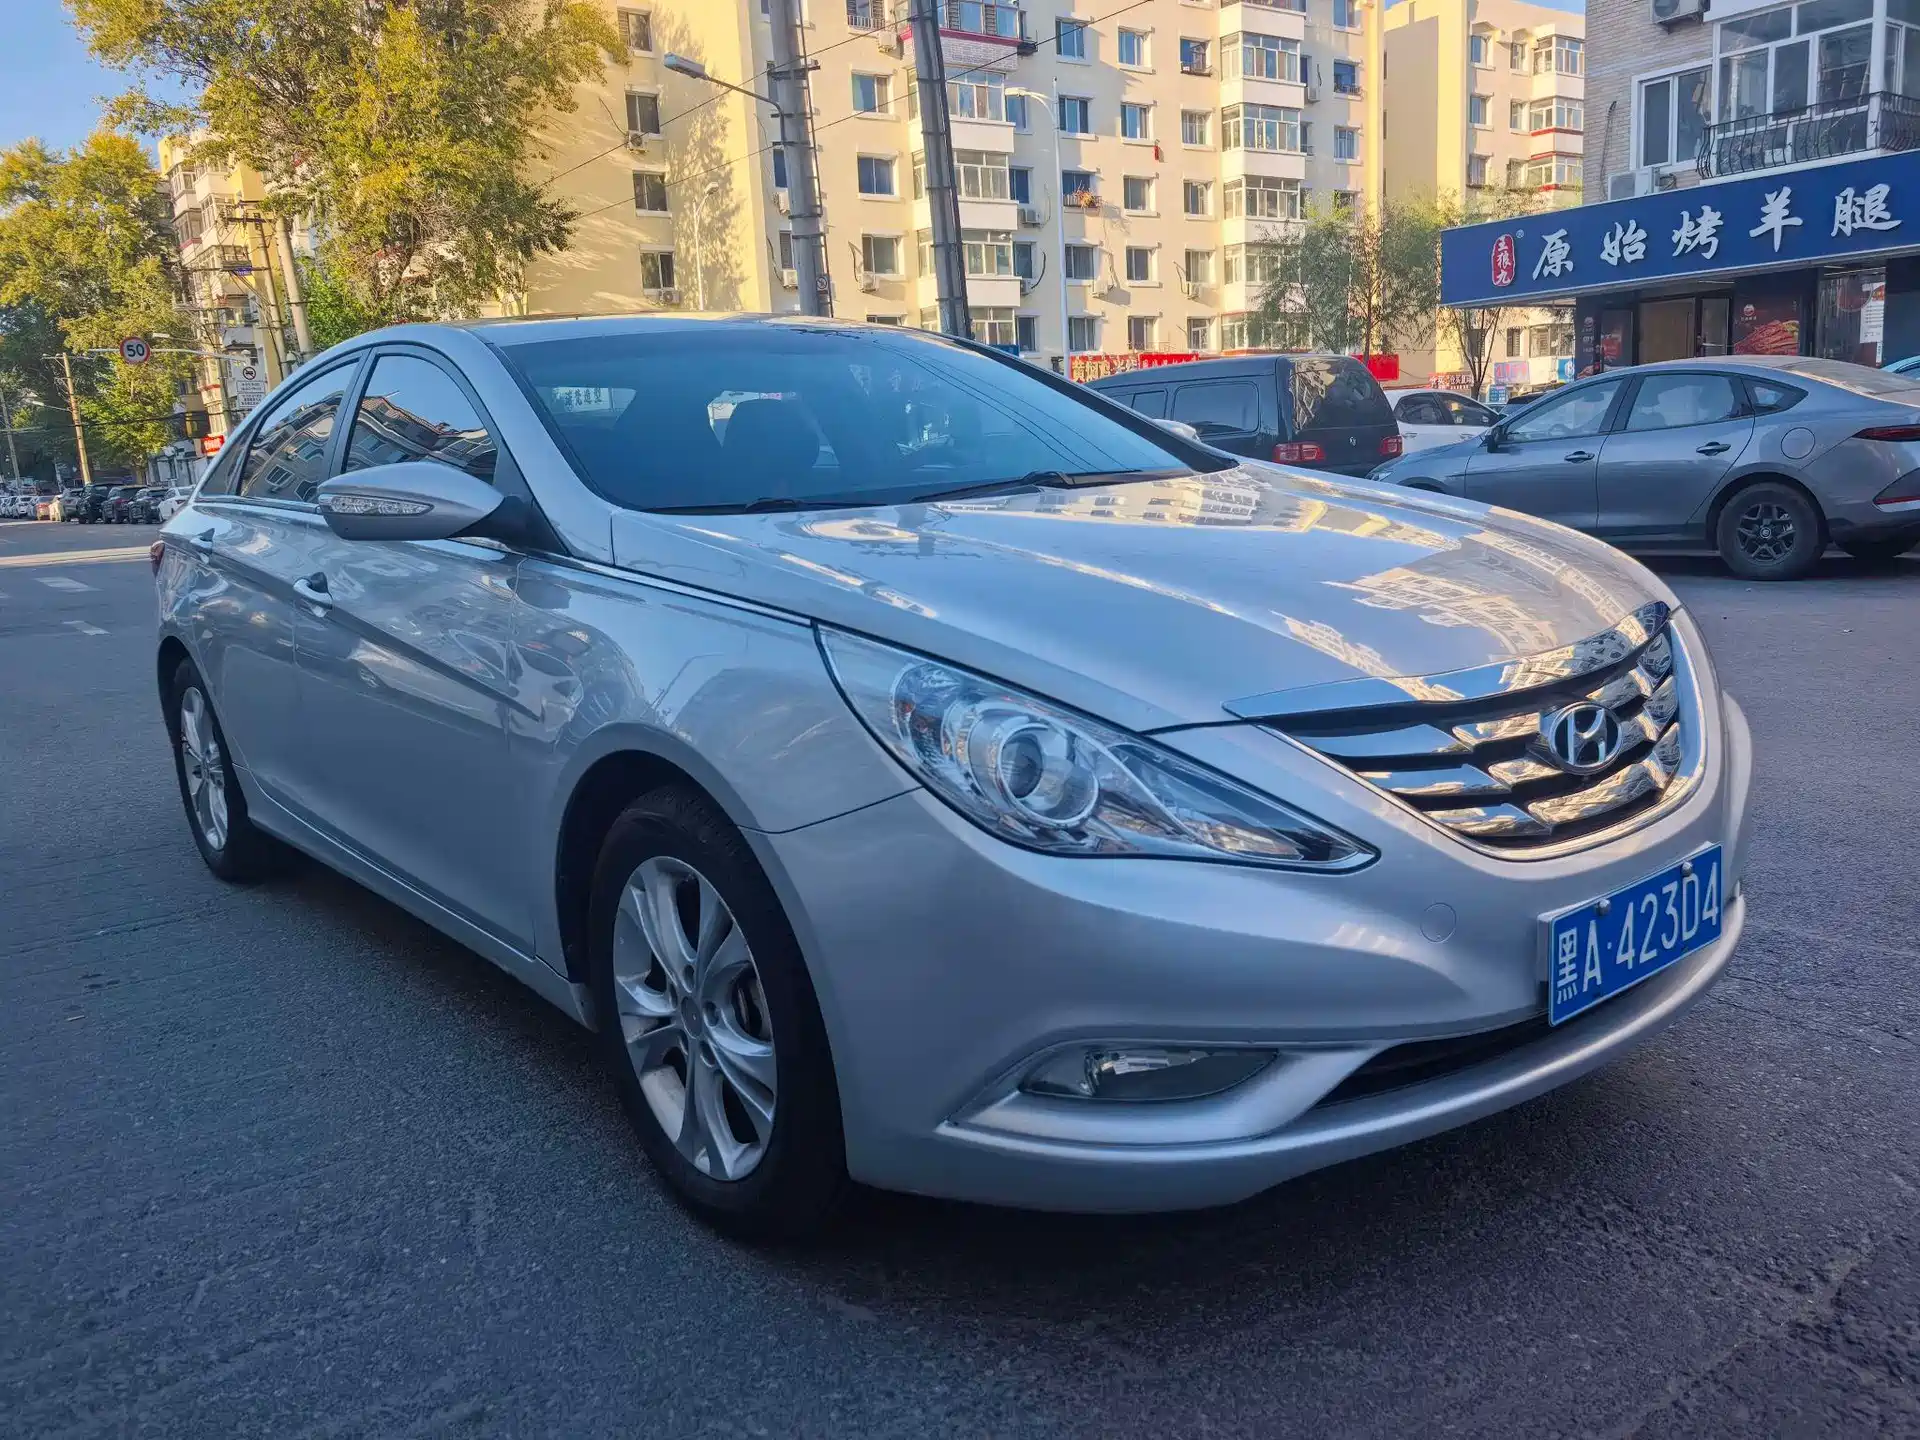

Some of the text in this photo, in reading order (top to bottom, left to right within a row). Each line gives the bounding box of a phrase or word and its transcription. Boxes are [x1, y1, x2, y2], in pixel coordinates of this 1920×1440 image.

[1532, 183, 1902, 281] 原始烤羊腿
[126, 343, 145, 357] 50
[1557, 862, 1719, 1004] 黑A·423D4
